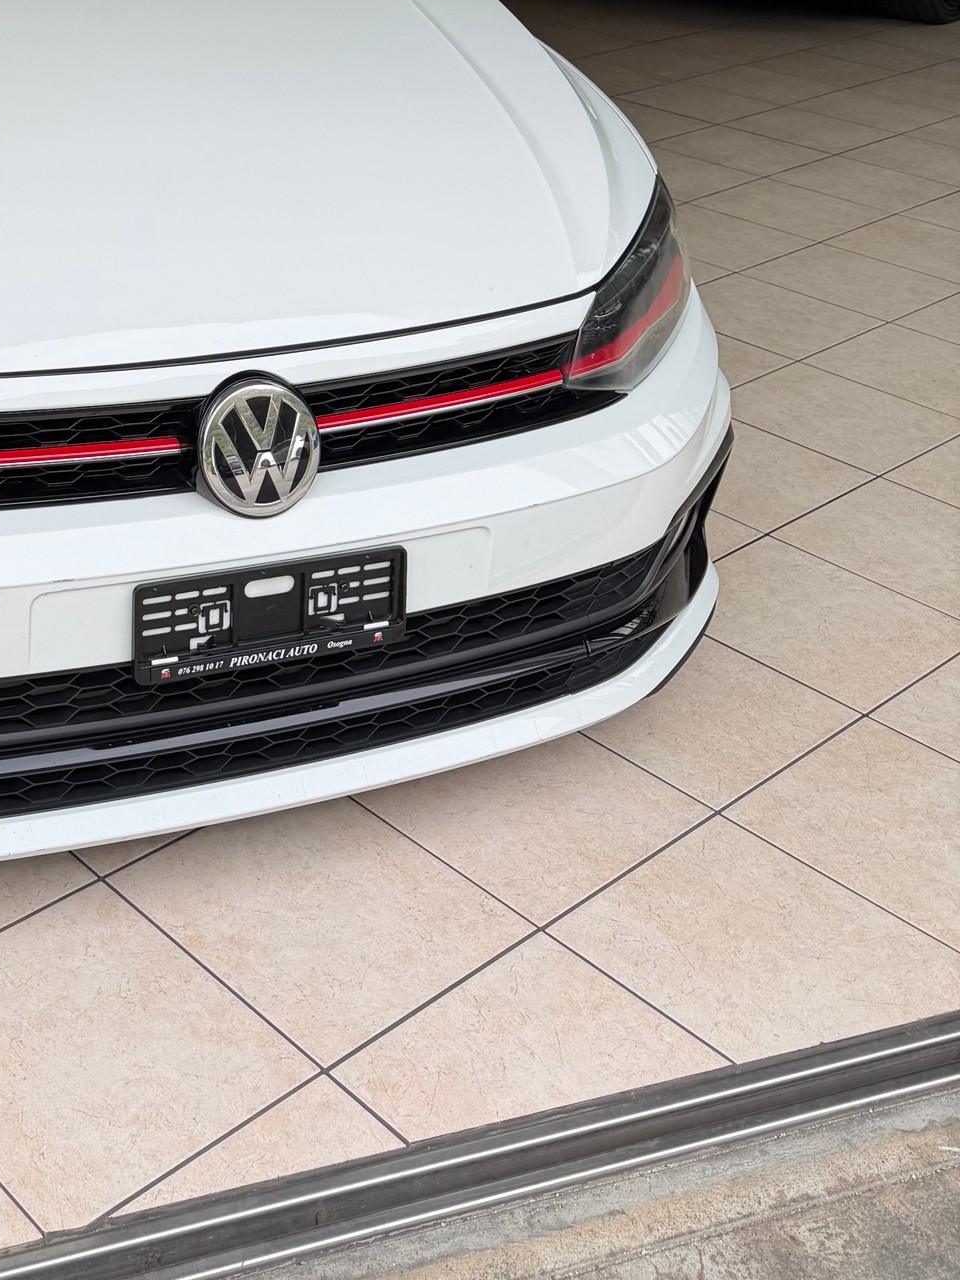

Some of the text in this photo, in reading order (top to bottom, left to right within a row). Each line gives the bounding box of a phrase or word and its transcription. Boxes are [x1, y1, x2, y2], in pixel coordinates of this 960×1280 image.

[211, 391, 313, 509] VW
[177, 639, 353, 675] 076 298 10 17 PIRONACI AUTO Osogna
